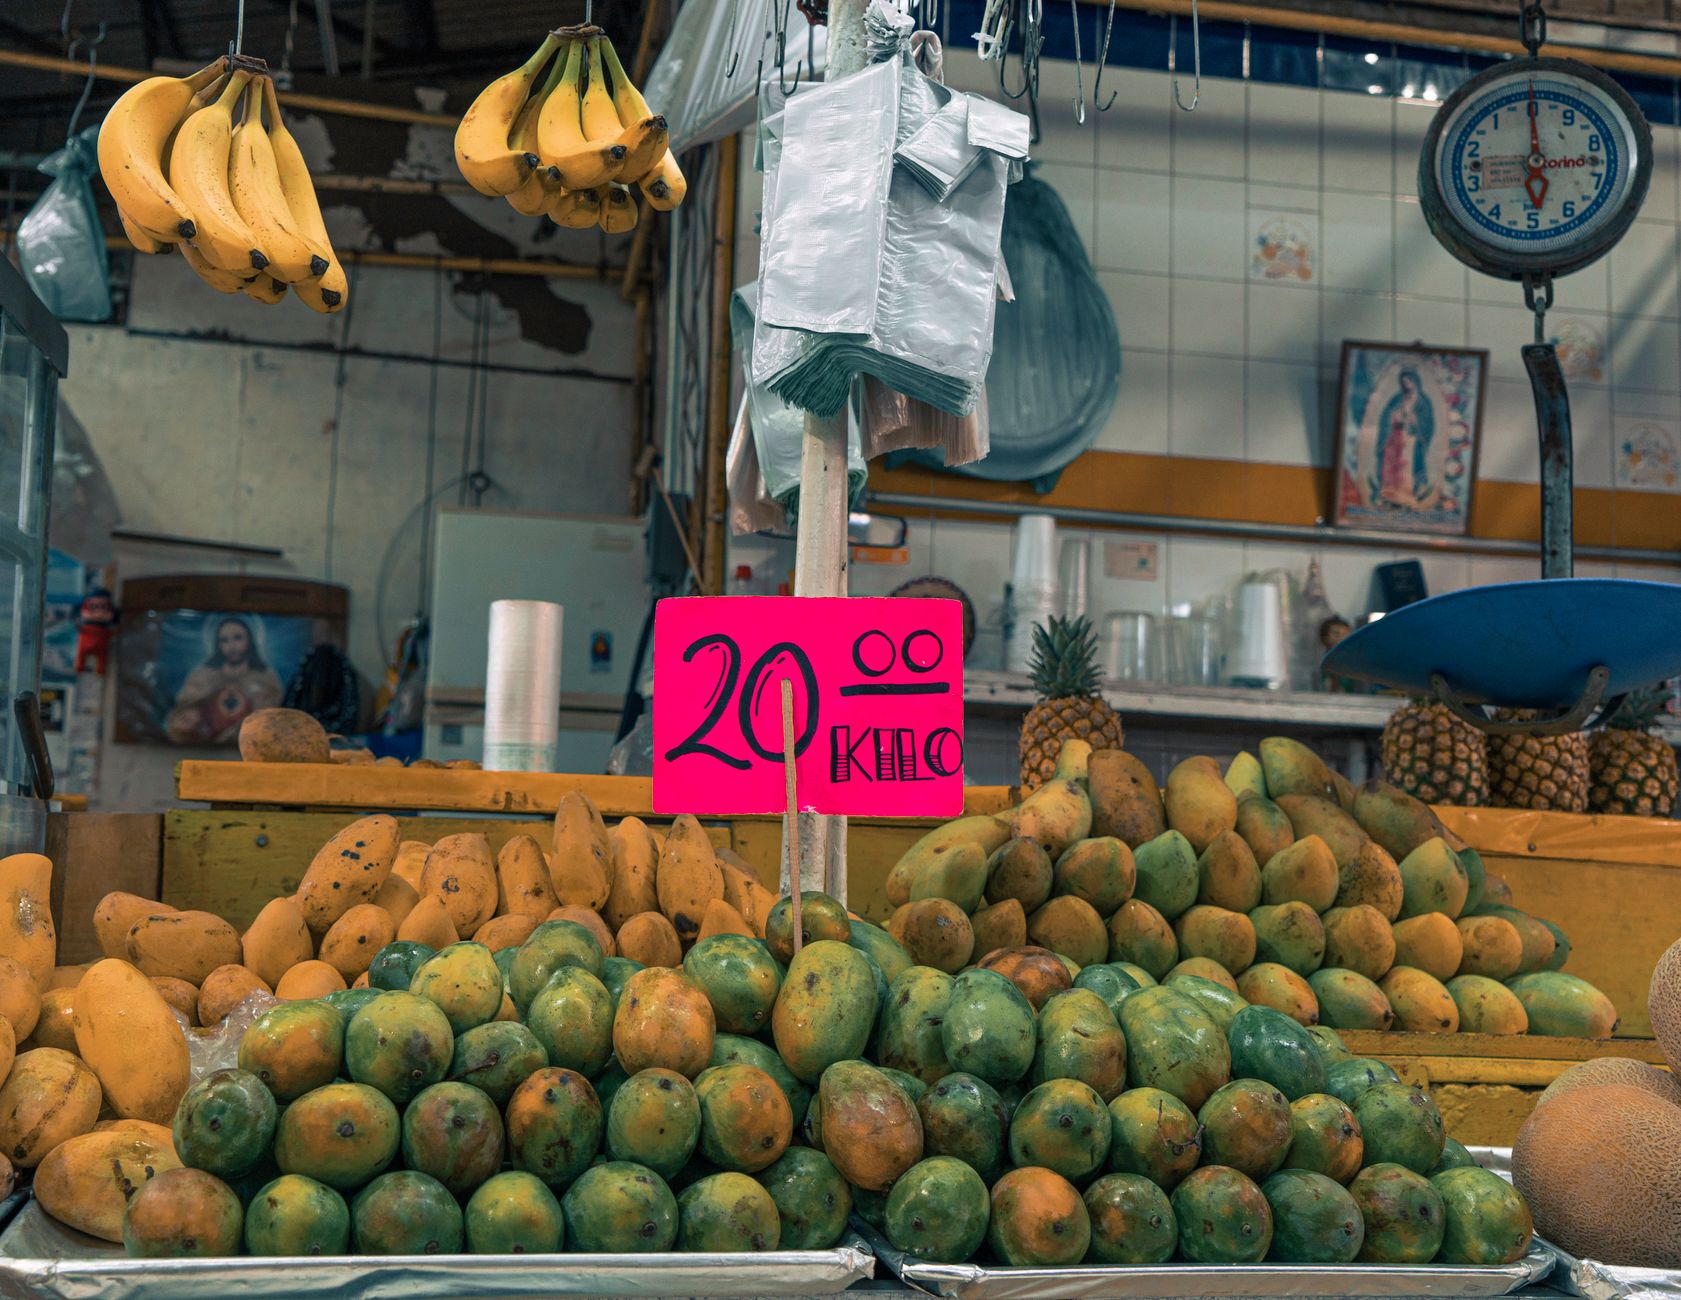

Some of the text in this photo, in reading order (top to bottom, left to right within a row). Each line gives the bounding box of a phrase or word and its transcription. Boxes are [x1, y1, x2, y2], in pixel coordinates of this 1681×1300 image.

[1527, 101, 1539, 117] 0
[1562, 109, 1575, 126] 9
[1492, 113, 1499, 130] 1
[1467, 141, 1480, 158] 2
[1588, 134, 1600, 152] 8
[1543, 155, 1585, 169] orino
[1467, 175, 1480, 192] 3
[1591, 171, 1603, 190] 7
[1488, 203, 1501, 220] 4
[1563, 201, 1575, 218] 6
[1527, 212, 1539, 229] 5
[664, 629, 944, 770] 20 00
[830, 725, 964, 783] KILO
